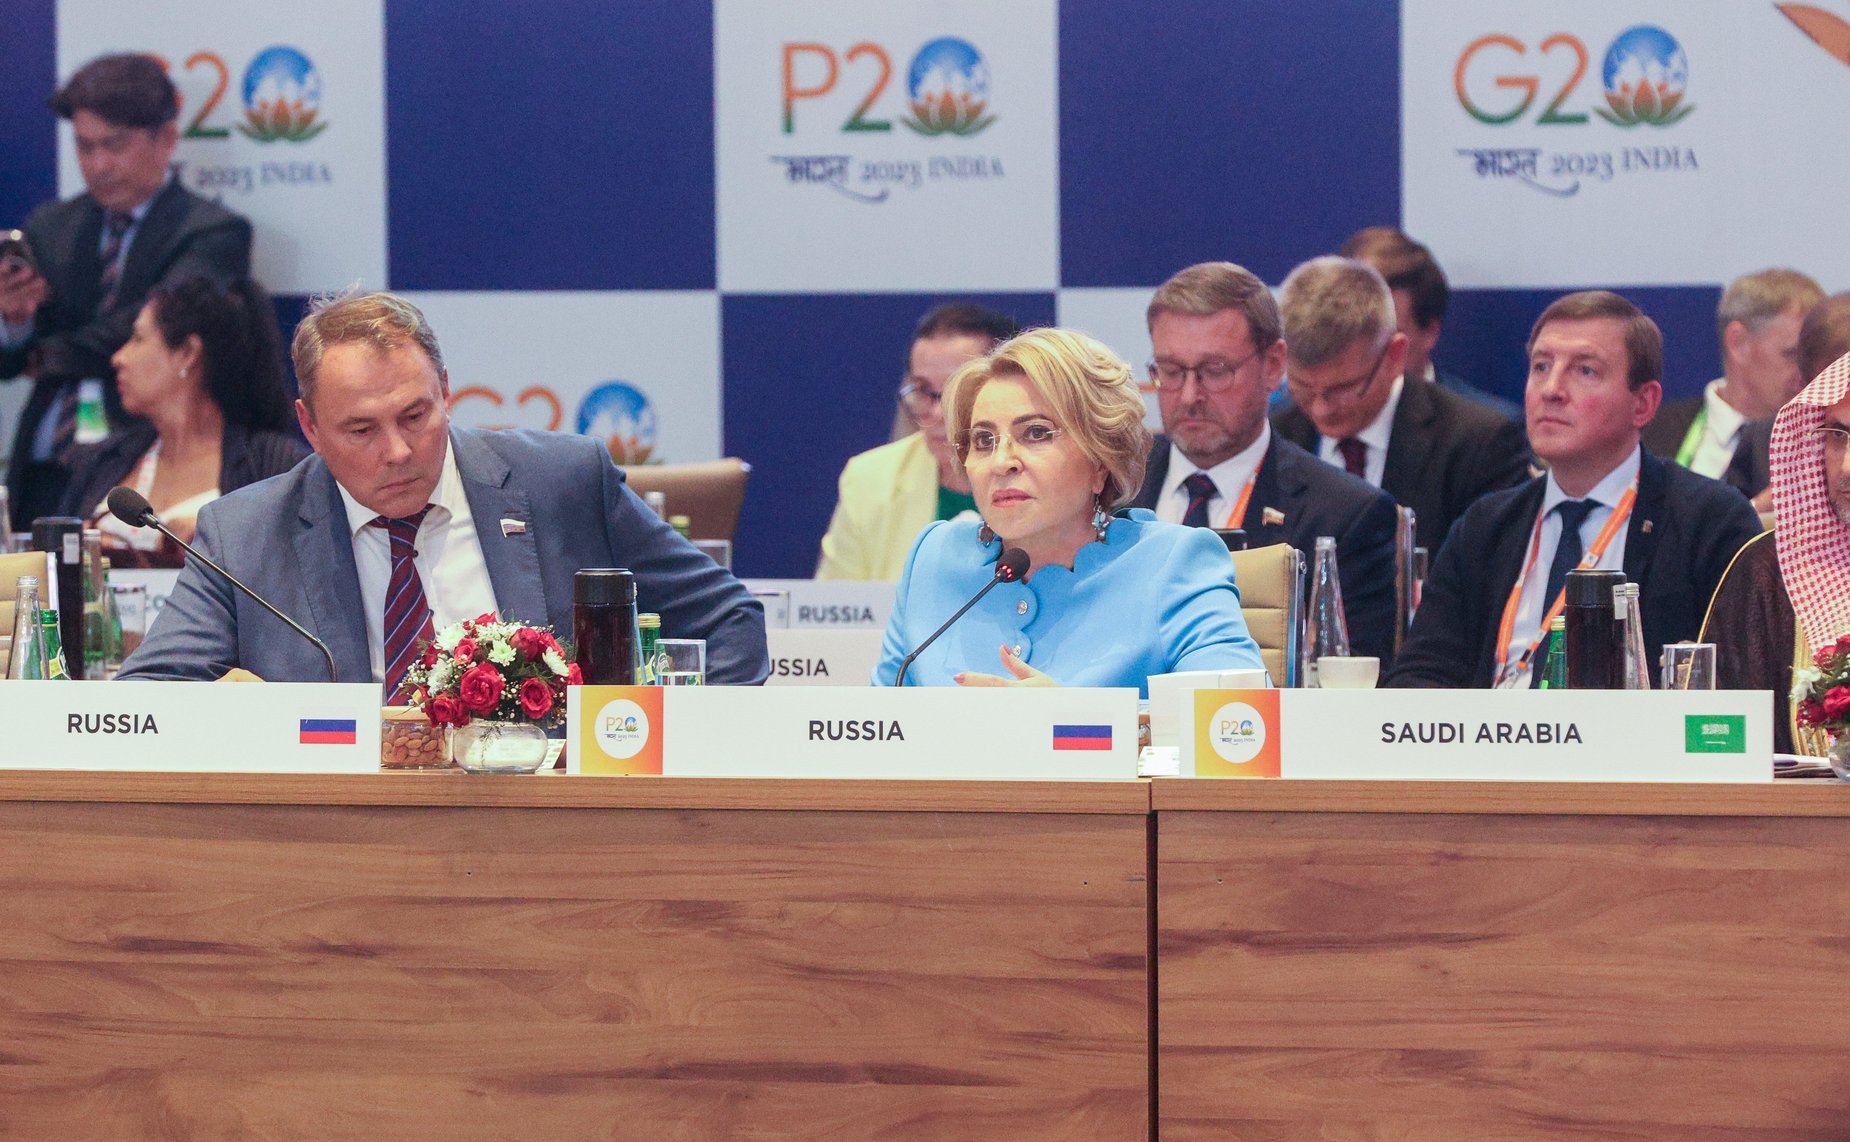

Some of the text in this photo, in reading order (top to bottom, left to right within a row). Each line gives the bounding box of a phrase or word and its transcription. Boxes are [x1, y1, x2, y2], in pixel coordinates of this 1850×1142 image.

[781, 35, 998, 136] P20
[1454, 24, 1696, 127] G20
[152, 45, 328, 142] 20
[928, 155, 1005, 178] INDIA
[1553, 152, 1614, 181] 2023
[1621, 147, 1698, 170] INDIA
[798, 605, 875, 622] RUSSIA
[769, 658, 829, 676] USSIA
[67, 713, 159, 734] RUSSIA
[808, 720, 905, 741] RUSSIA
[1381, 722, 1583, 744] SAUDI ARABIA
